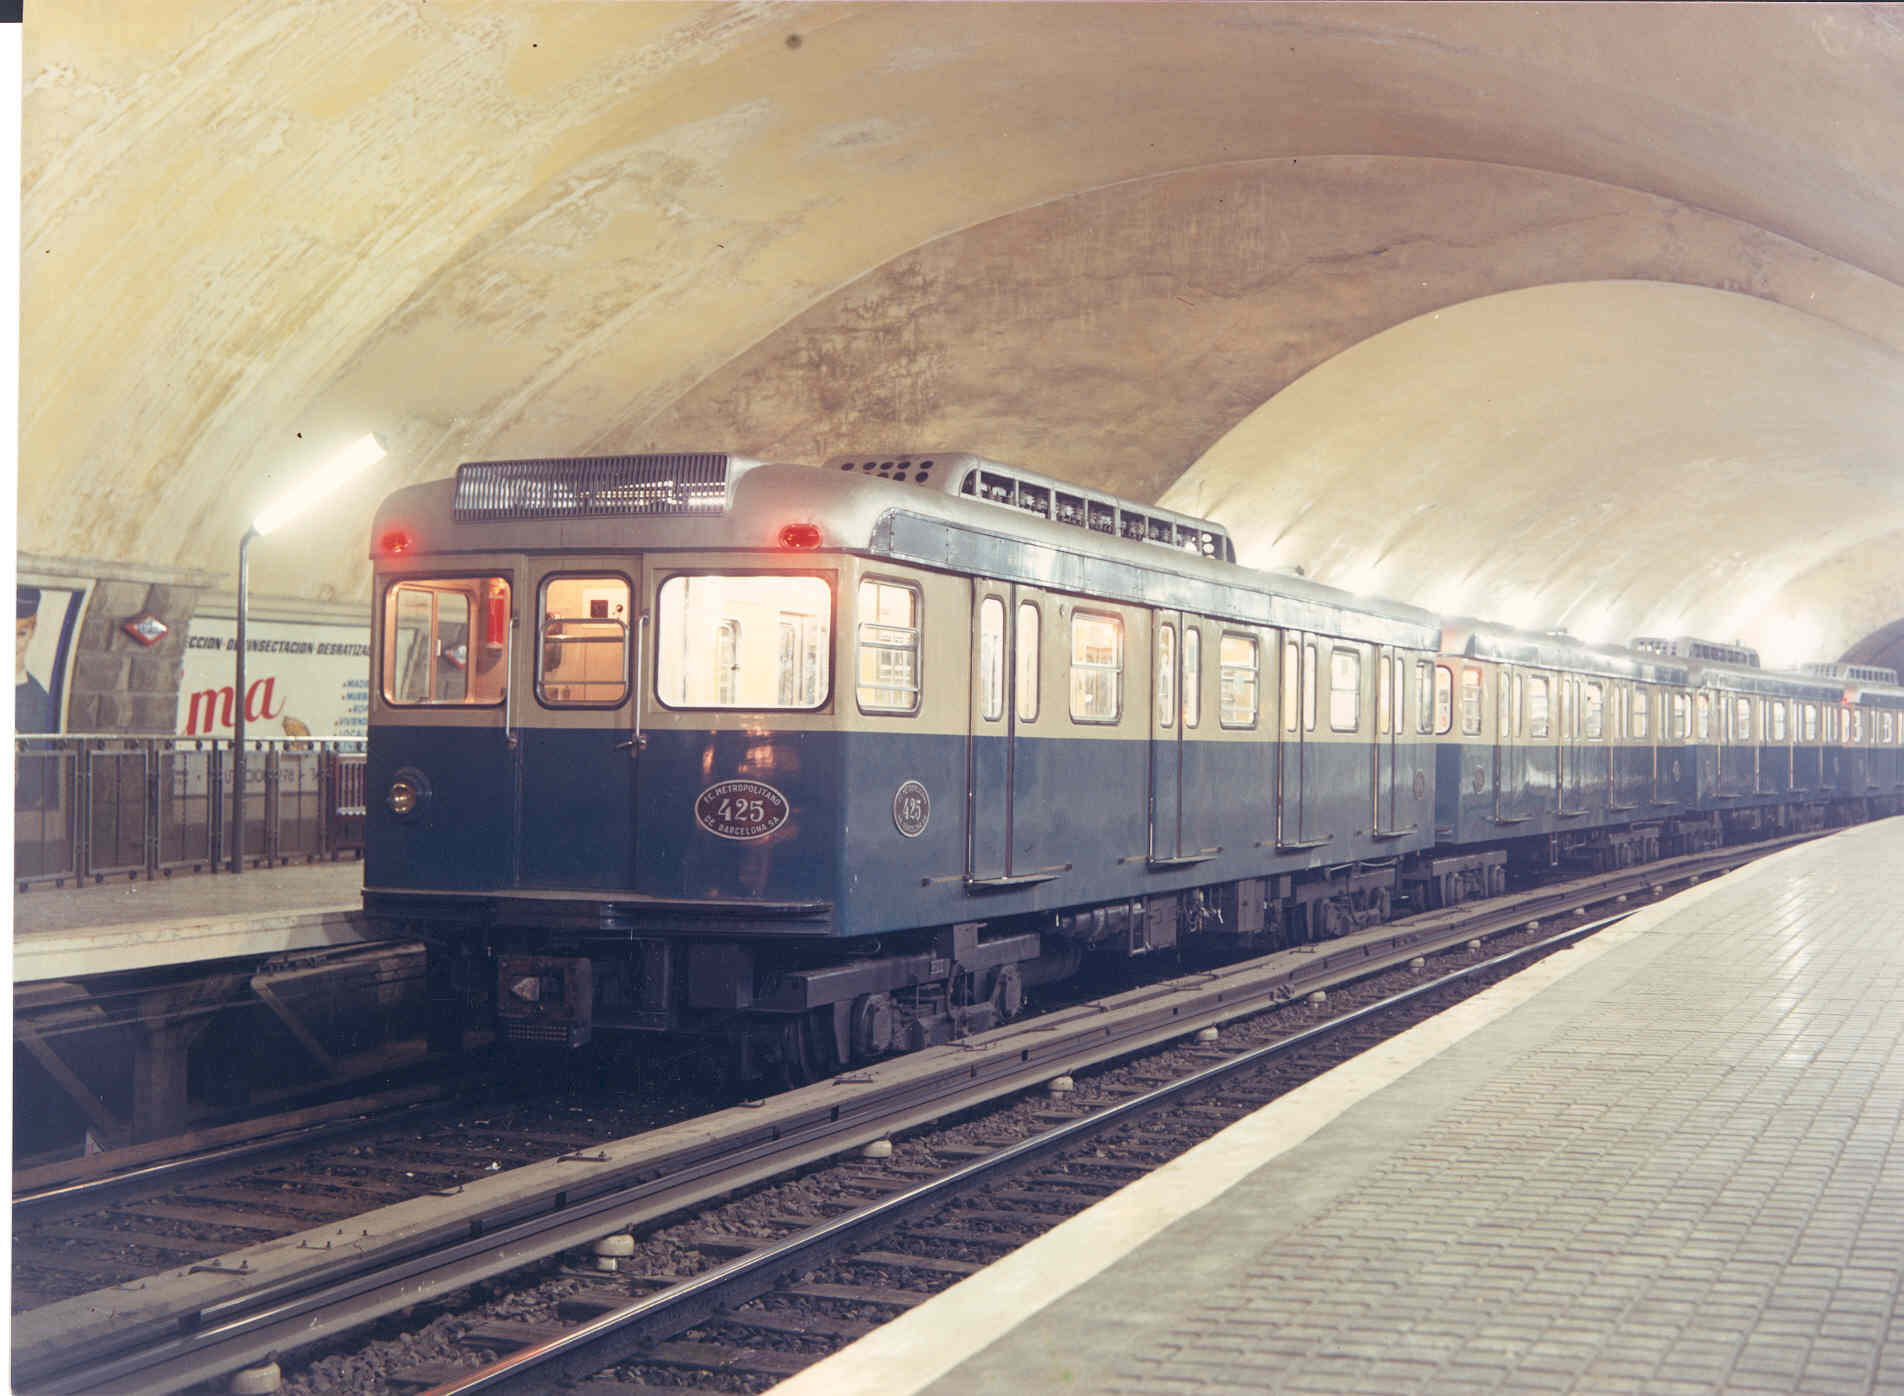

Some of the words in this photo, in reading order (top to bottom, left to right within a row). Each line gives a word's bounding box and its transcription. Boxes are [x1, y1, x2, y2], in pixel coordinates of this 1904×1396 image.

[316, 642, 369, 657] DESRATIZA
[718, 798, 764, 822] 425
[903, 798, 920, 820] 425
[718, 823, 767, 835] BARCELONA
